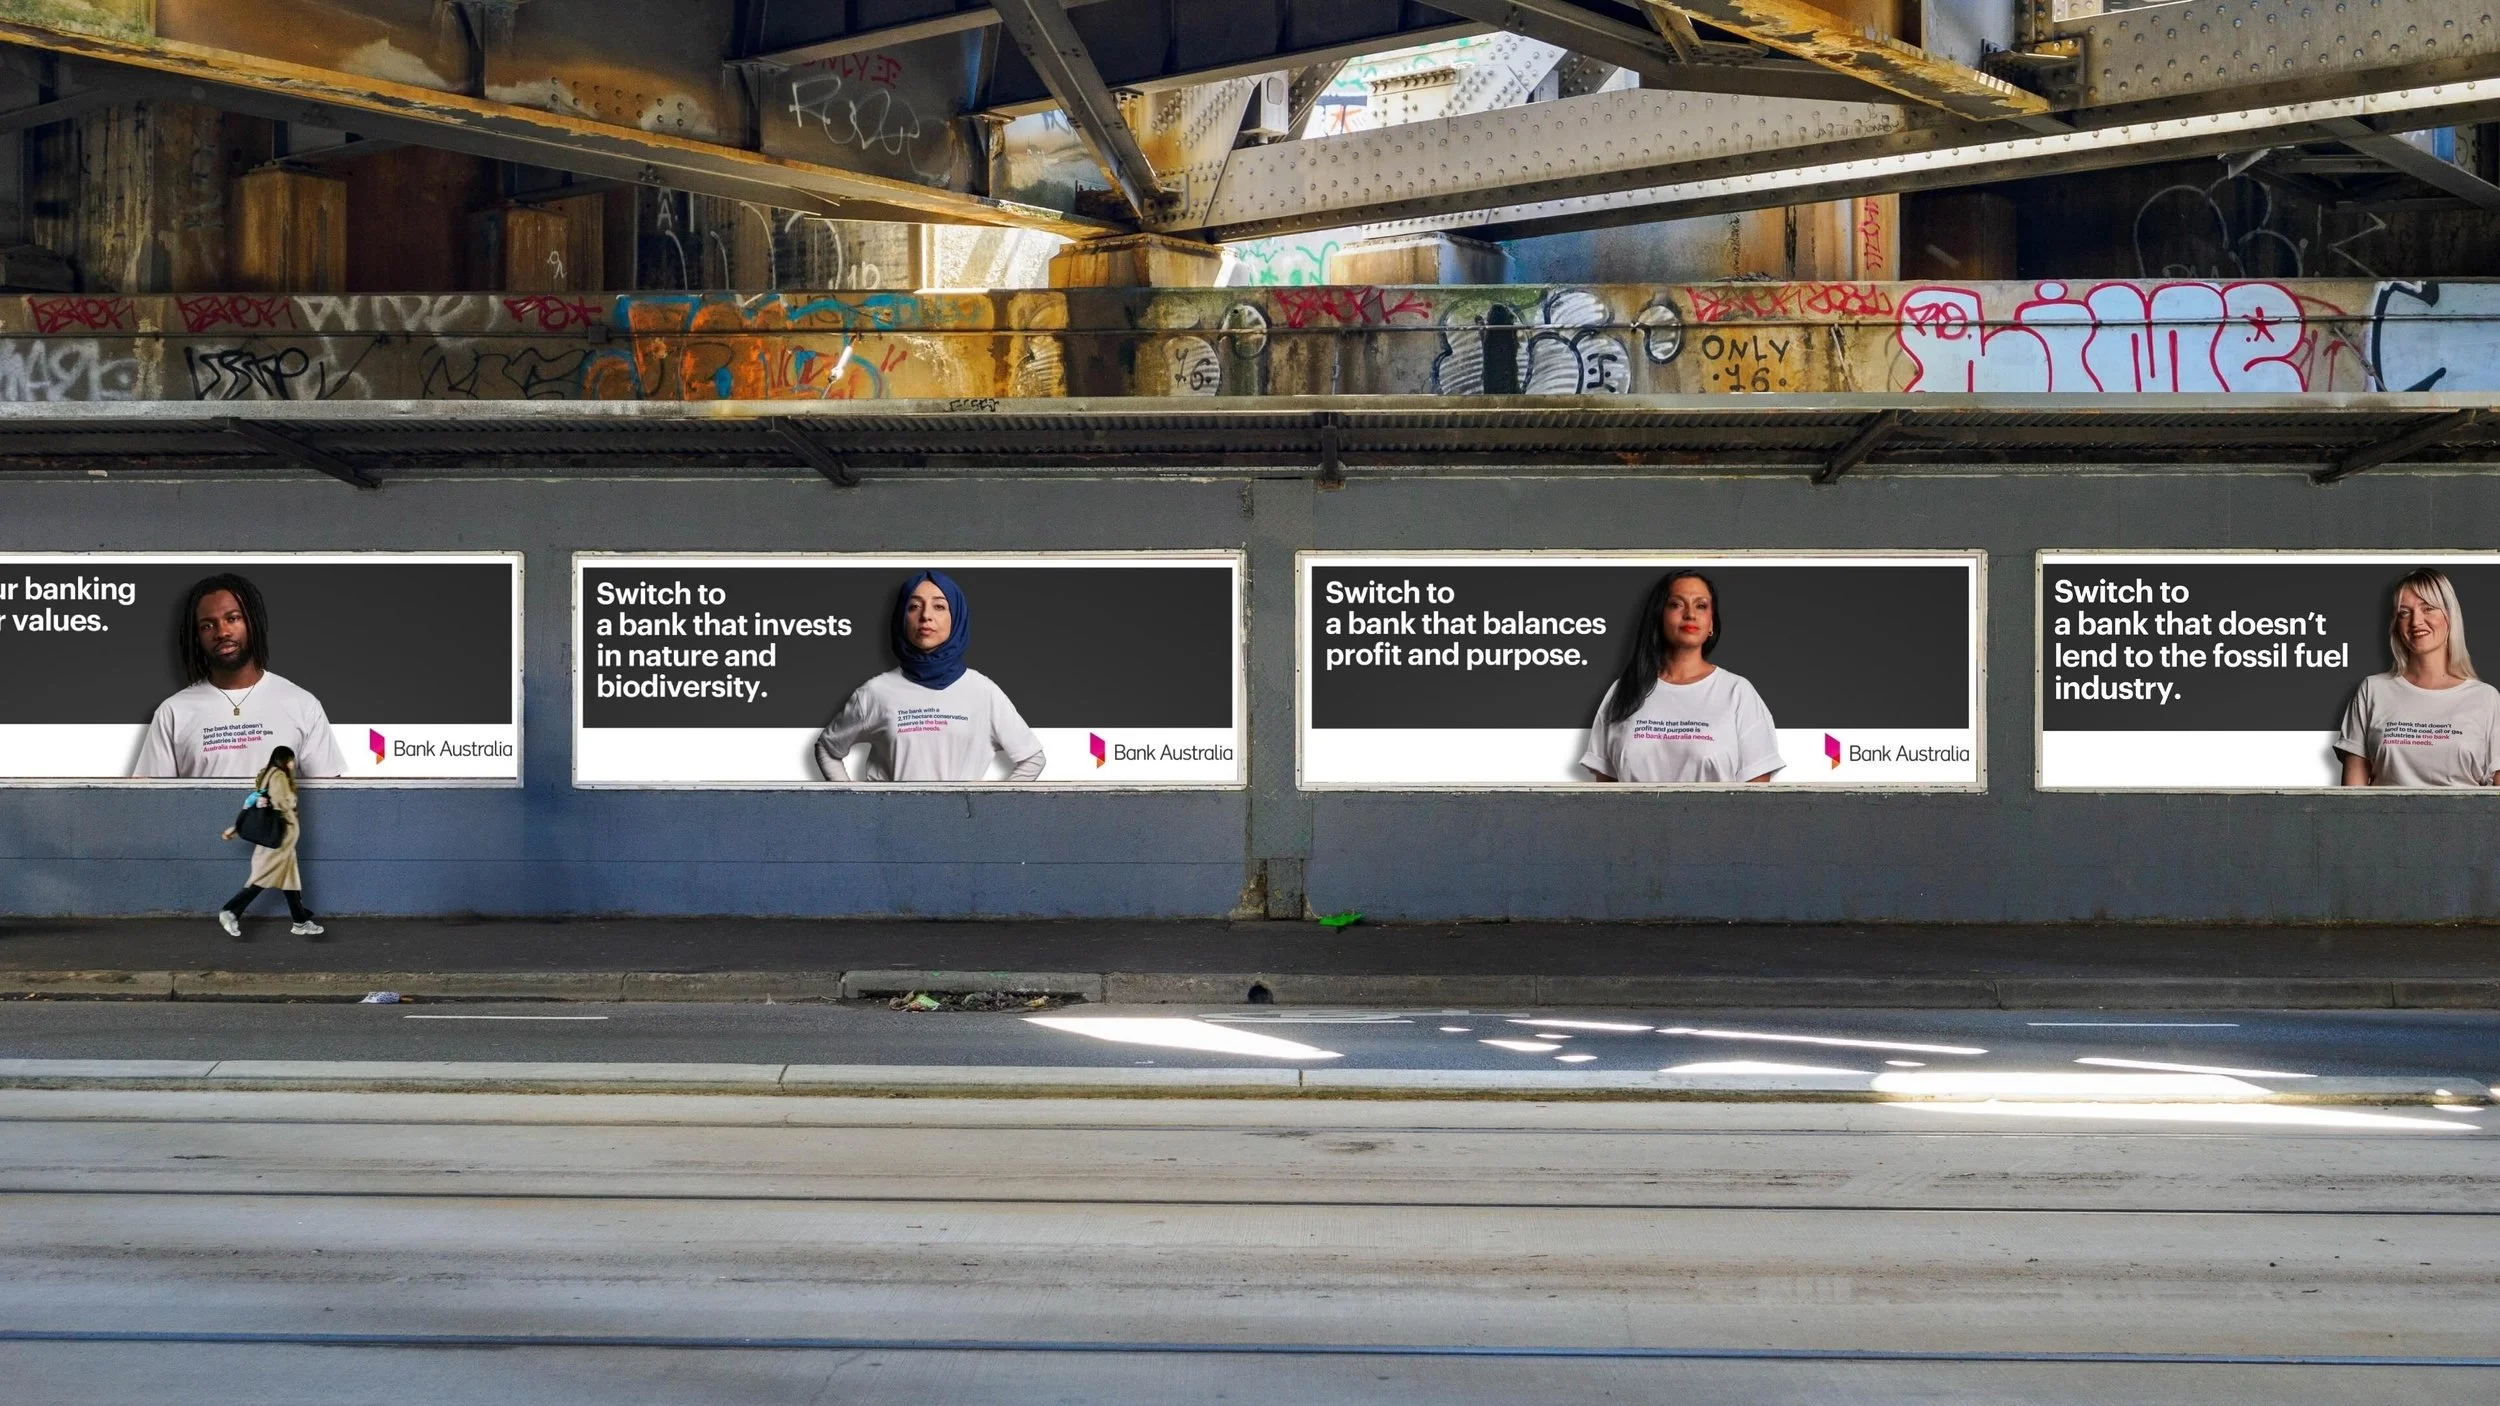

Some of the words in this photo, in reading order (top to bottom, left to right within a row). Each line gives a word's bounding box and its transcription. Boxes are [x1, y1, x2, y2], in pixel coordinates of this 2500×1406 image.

[1701, 334, 1791, 364] ONLY
[26, 576, 135, 605] banking
[597, 581, 690, 605] Switch
[698, 585, 725, 605] to
[1326, 580, 1419, 603] Switch
[1427, 584, 1454, 603] to
[2055, 579, 2152, 603] Switch
[2160, 582, 2189, 603] to
[12, 608, 108, 631] values.
[597, 619, 611, 635] a
[620, 612, 687, 635] bank
[693, 612, 747, 635] that
[755, 612, 852, 636] invests
[1326, 618, 1341, 634] a
[1349, 611, 1416, 634] bank
[1422, 611, 1476, 634] that
[1484, 611, 1606, 634] balances
[2055, 618, 2070, 635] a
[2079, 611, 2148, 635] bank
[2155, 611, 2212, 635] that
[2219, 611, 2326, 635] doesn’t
[598, 643, 621, 666] in
[629, 647, 718, 666] nature
[725, 643, 775, 666] and
[1327, 642, 1401, 670] profit
[1408, 642, 1458, 665] and
[1467, 649, 1587, 670] purpose.
[2056, 643, 2116, 667] lend
[2124, 647, 2153, 667] to
[2160, 643, 2206, 667] the
[2213, 643, 2287, 667] fossil
[2294, 643, 2348, 667] fuel
[598, 674, 767, 702] biodiversity.
[2056, 675, 2181, 705] industry.
[1634, 725, 1652, 733] profit
[203, 744, 228, 752] Australia
[395, 741, 435, 756] Bank
[440, 741, 512, 756] Australia
[1115, 744, 1155, 760] Bank
[1160, 744, 1232, 760] Australia
[1850, 745, 1891, 761] Bank
[1896, 745, 1969, 761] Australia
